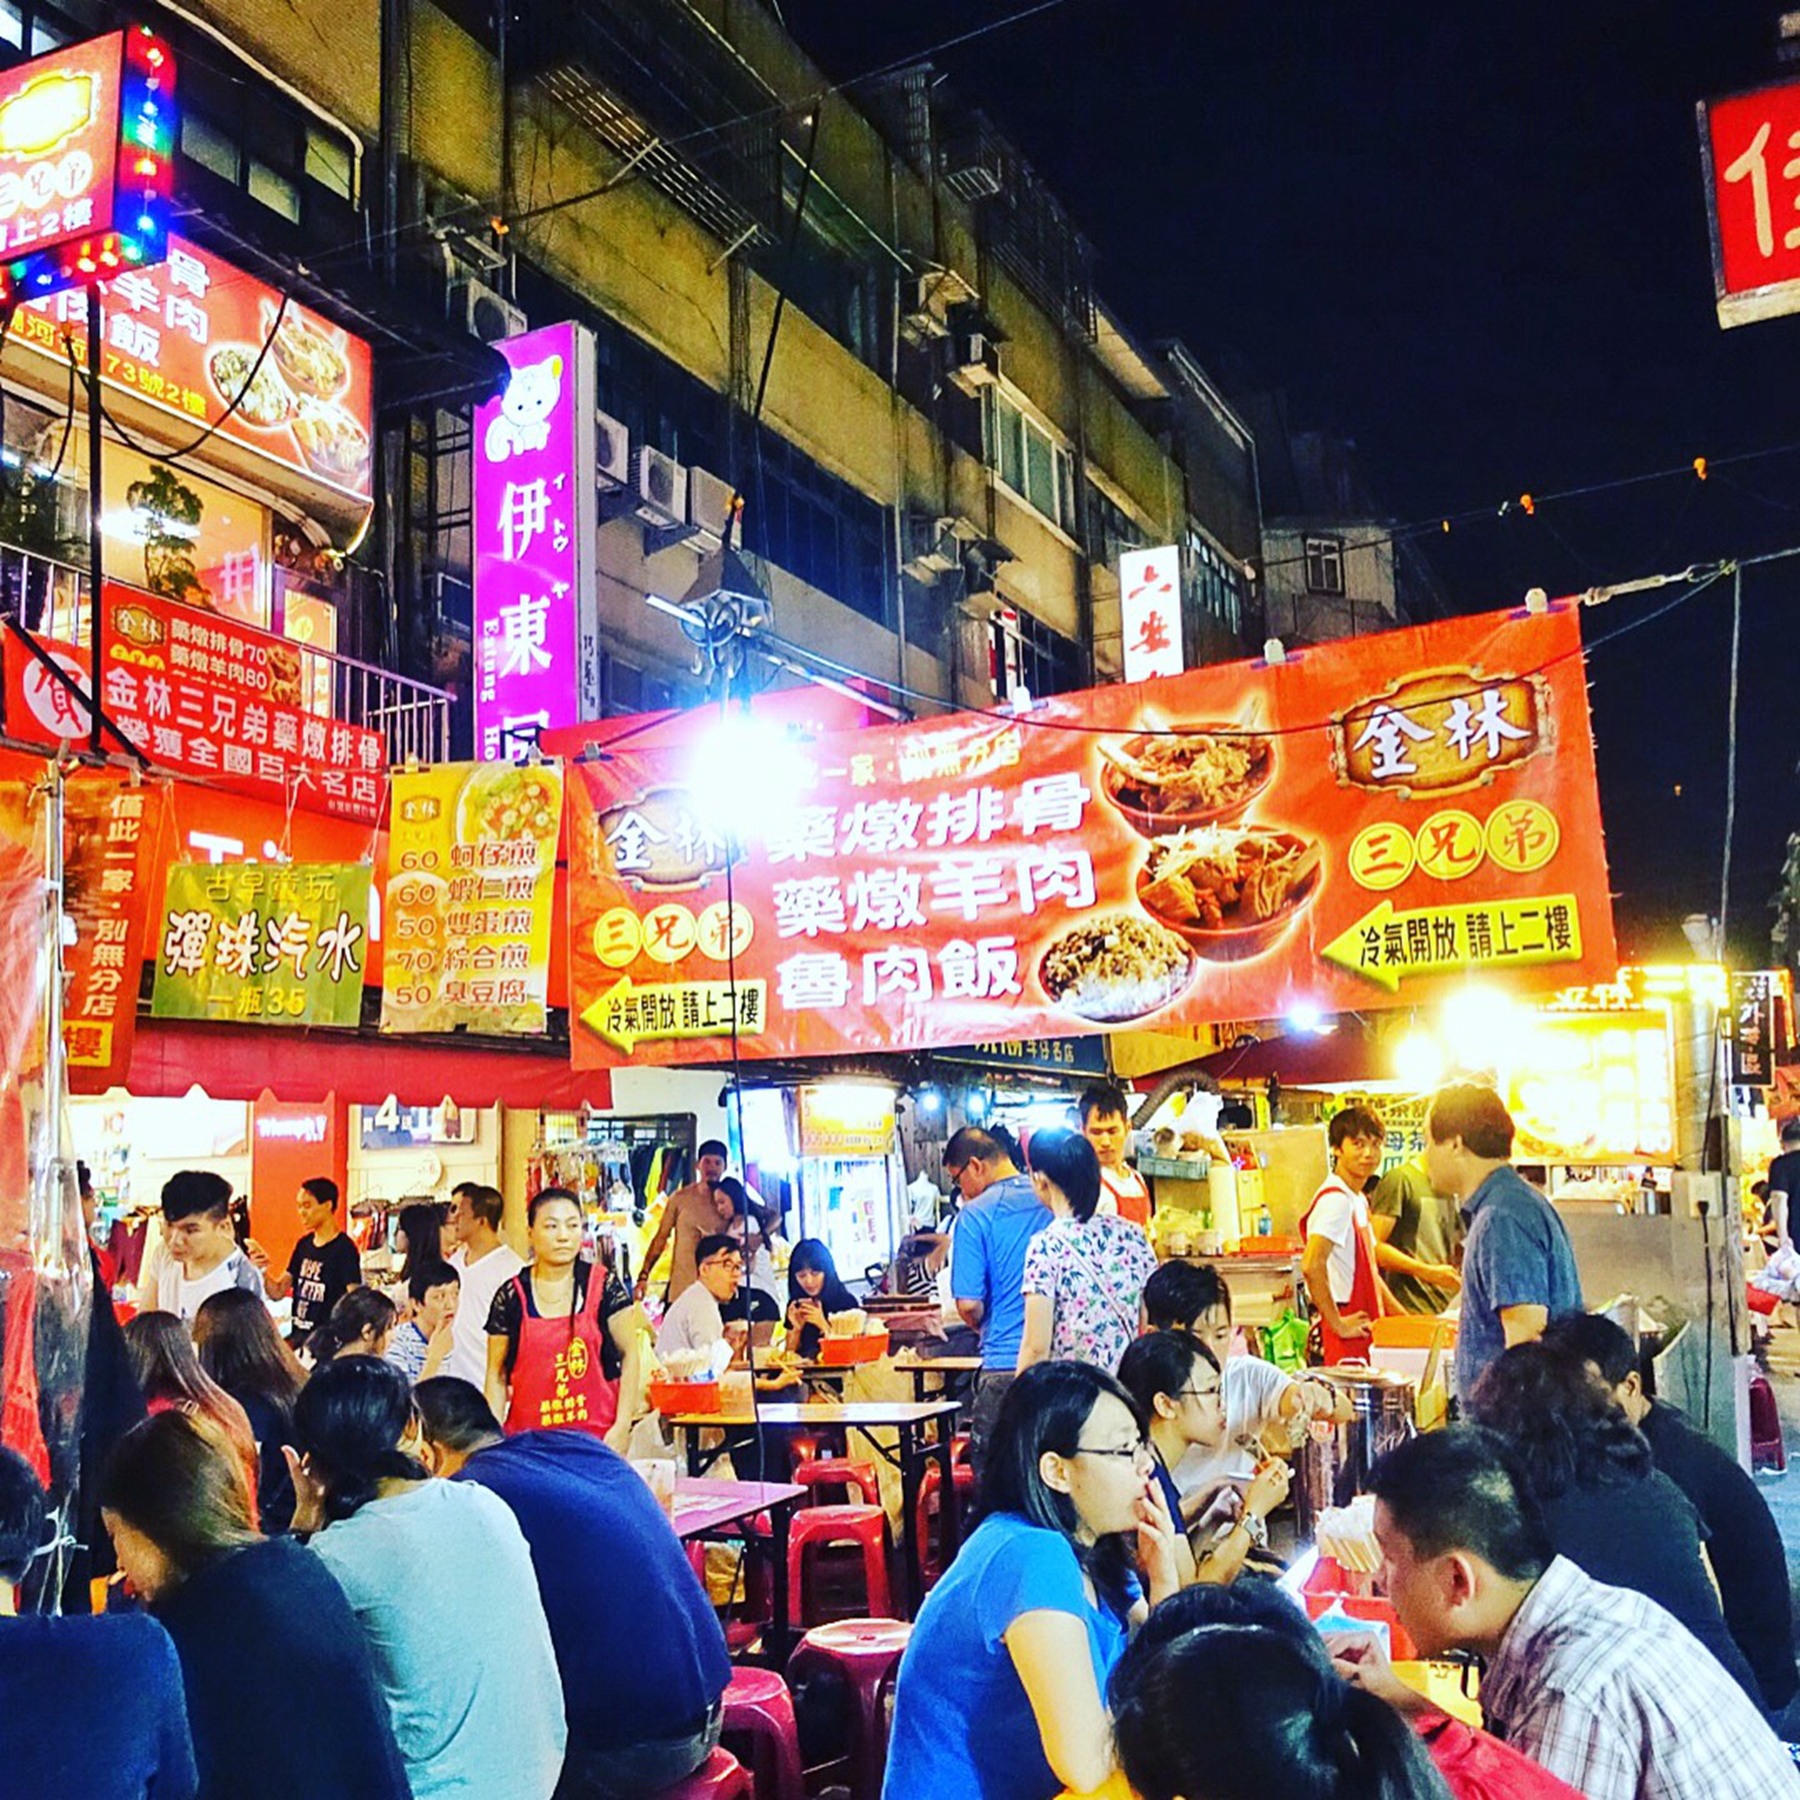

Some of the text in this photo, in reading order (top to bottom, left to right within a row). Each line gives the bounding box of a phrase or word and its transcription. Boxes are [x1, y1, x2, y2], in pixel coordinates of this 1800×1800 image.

[167, 248, 210, 298] 骨
[97, 272, 209, 344] 羊肉
[117, 609, 163, 642] 金林
[106, 667, 382, 774] 金林三兄弟藥燉排骨
[484, 724, 500, 761] Ho
[1355, 688, 1533, 780] 金林
[767, 773, 1092, 863] 藥燉排骨
[1362, 804, 1549, 876] 三兄弟
[400, 841, 538, 870] 60 蚵仔煎
[398, 884, 437, 904] 60
[772, 849, 1097, 938] 藥燉羊肉
[164, 911, 364, 981] 彈珠汽水
[398, 918, 437, 937] 50
[603, 909, 744, 954] 三兄弟
[1360, 904, 1572, 968] 冷氣開放 請上二樓
[396, 943, 530, 971] 70 綜合煎
[776, 936, 1024, 1010] 魯肉飯
[206, 987, 307, 1016] 一瓶35
[395, 979, 528, 1006] 50 臭豆腐
[607, 988, 759, 1034] 冷氣開放 請上二樓
